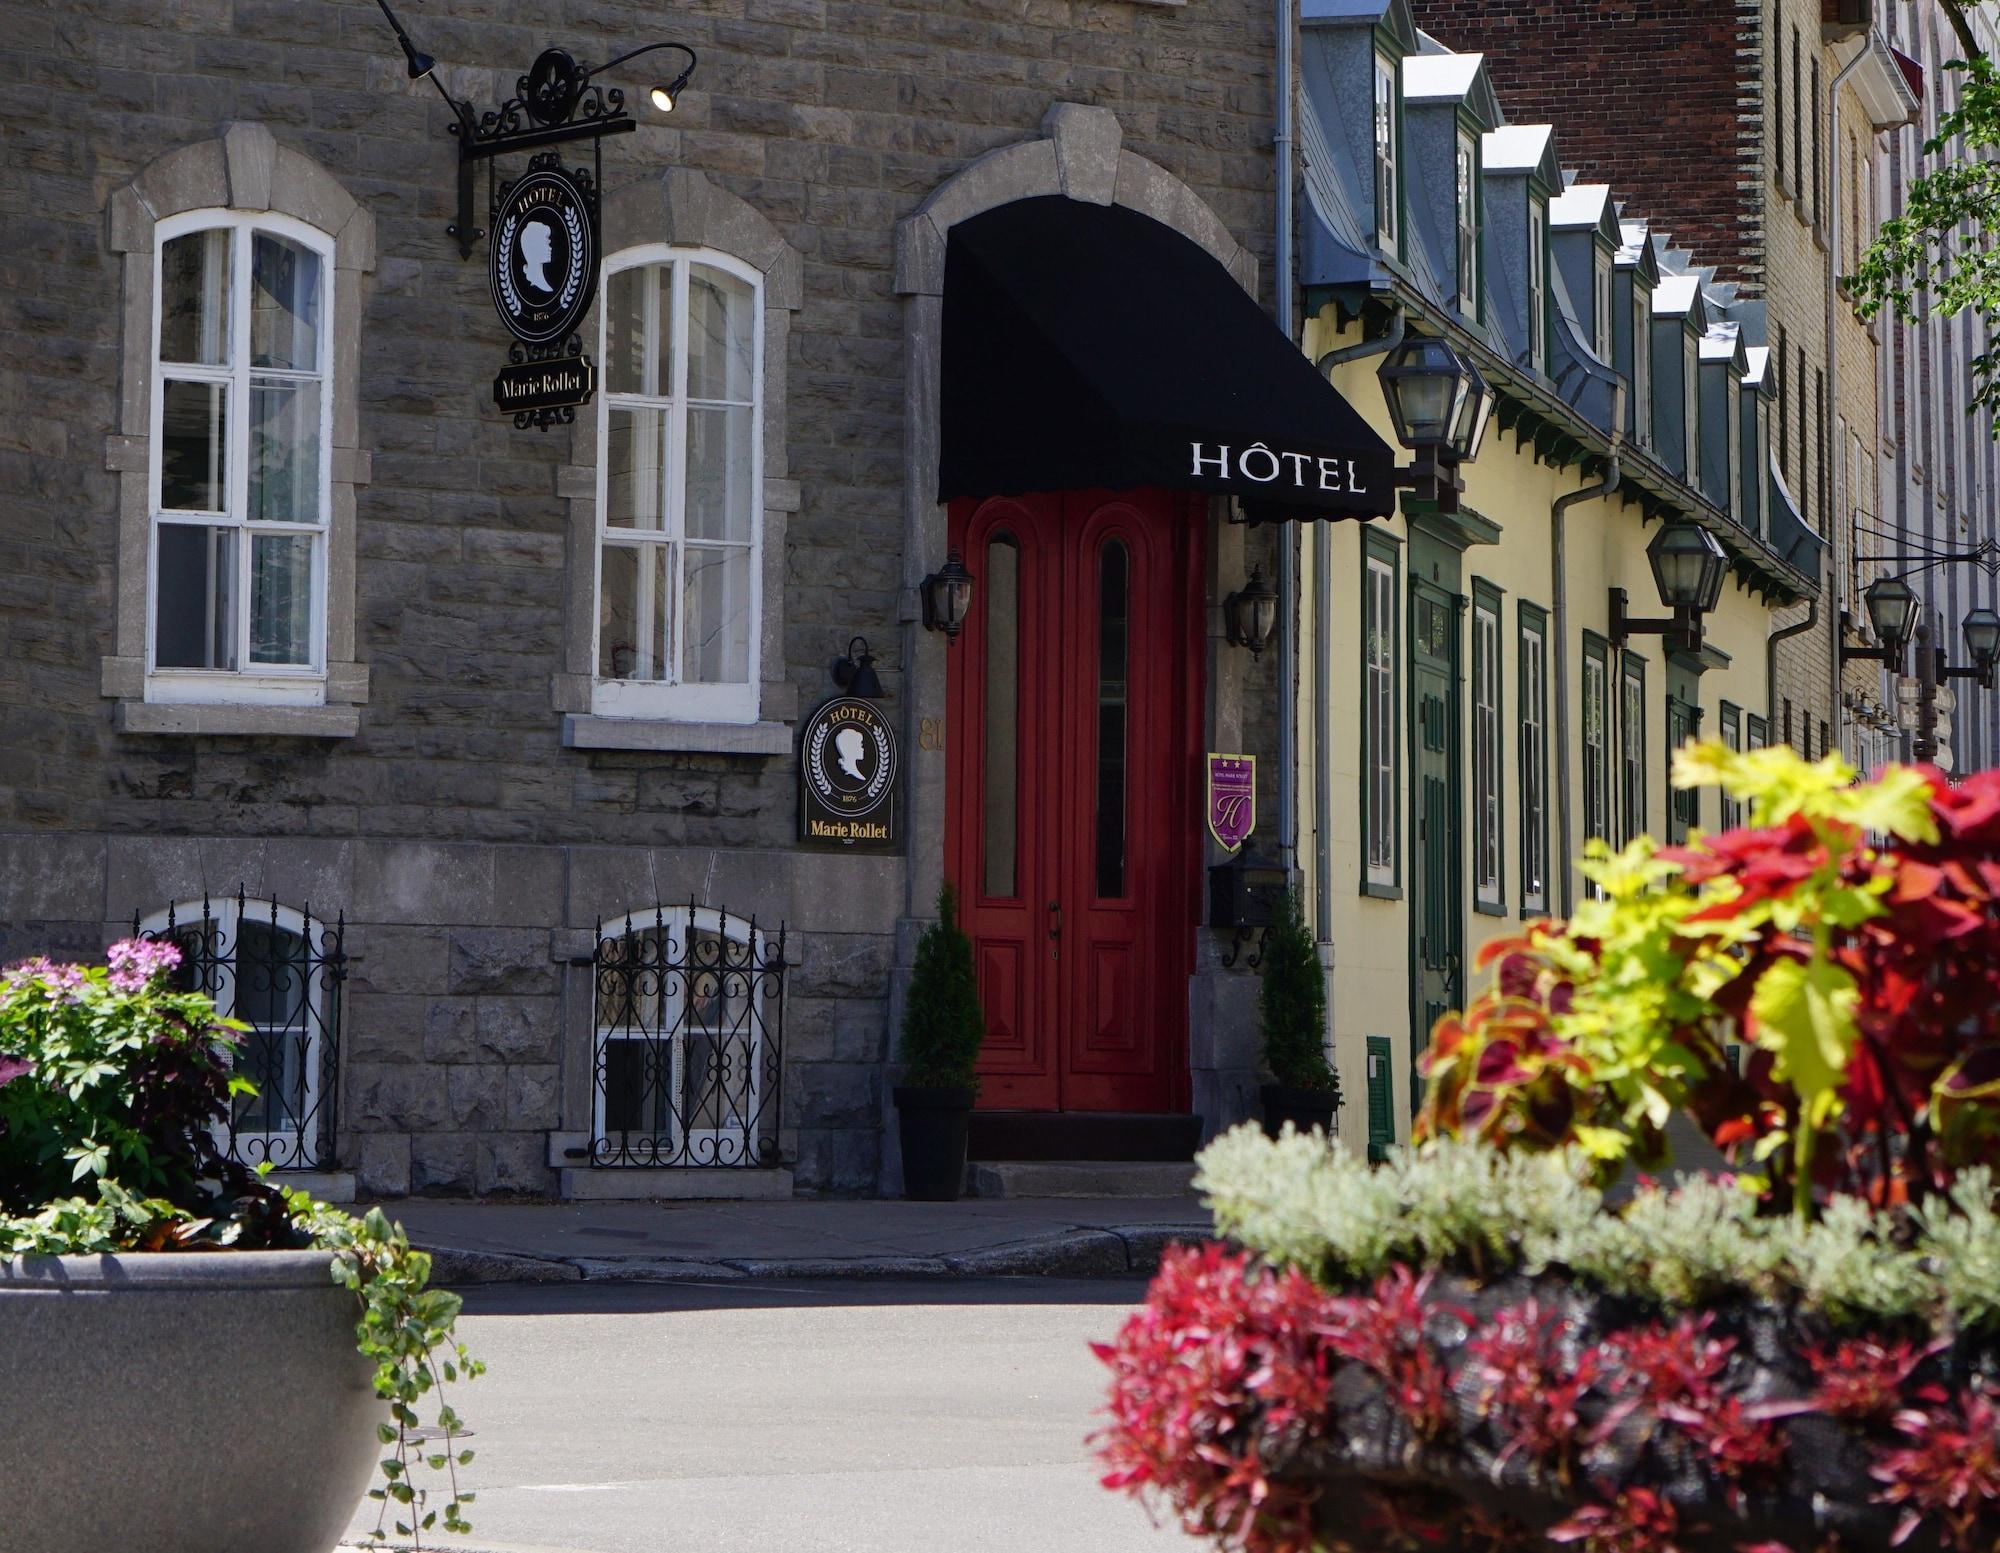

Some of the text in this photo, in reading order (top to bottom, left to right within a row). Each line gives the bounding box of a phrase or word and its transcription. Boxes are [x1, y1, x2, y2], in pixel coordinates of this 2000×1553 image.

[502, 371, 581, 398] Marie Rollet
[1190, 441, 1367, 494] HÔTEL
[830, 706, 874, 726] HÔTEL
[918, 718, 946, 751] 81
[842, 795, 857, 803] 1876
[811, 820, 888, 839] Marie Rollet
